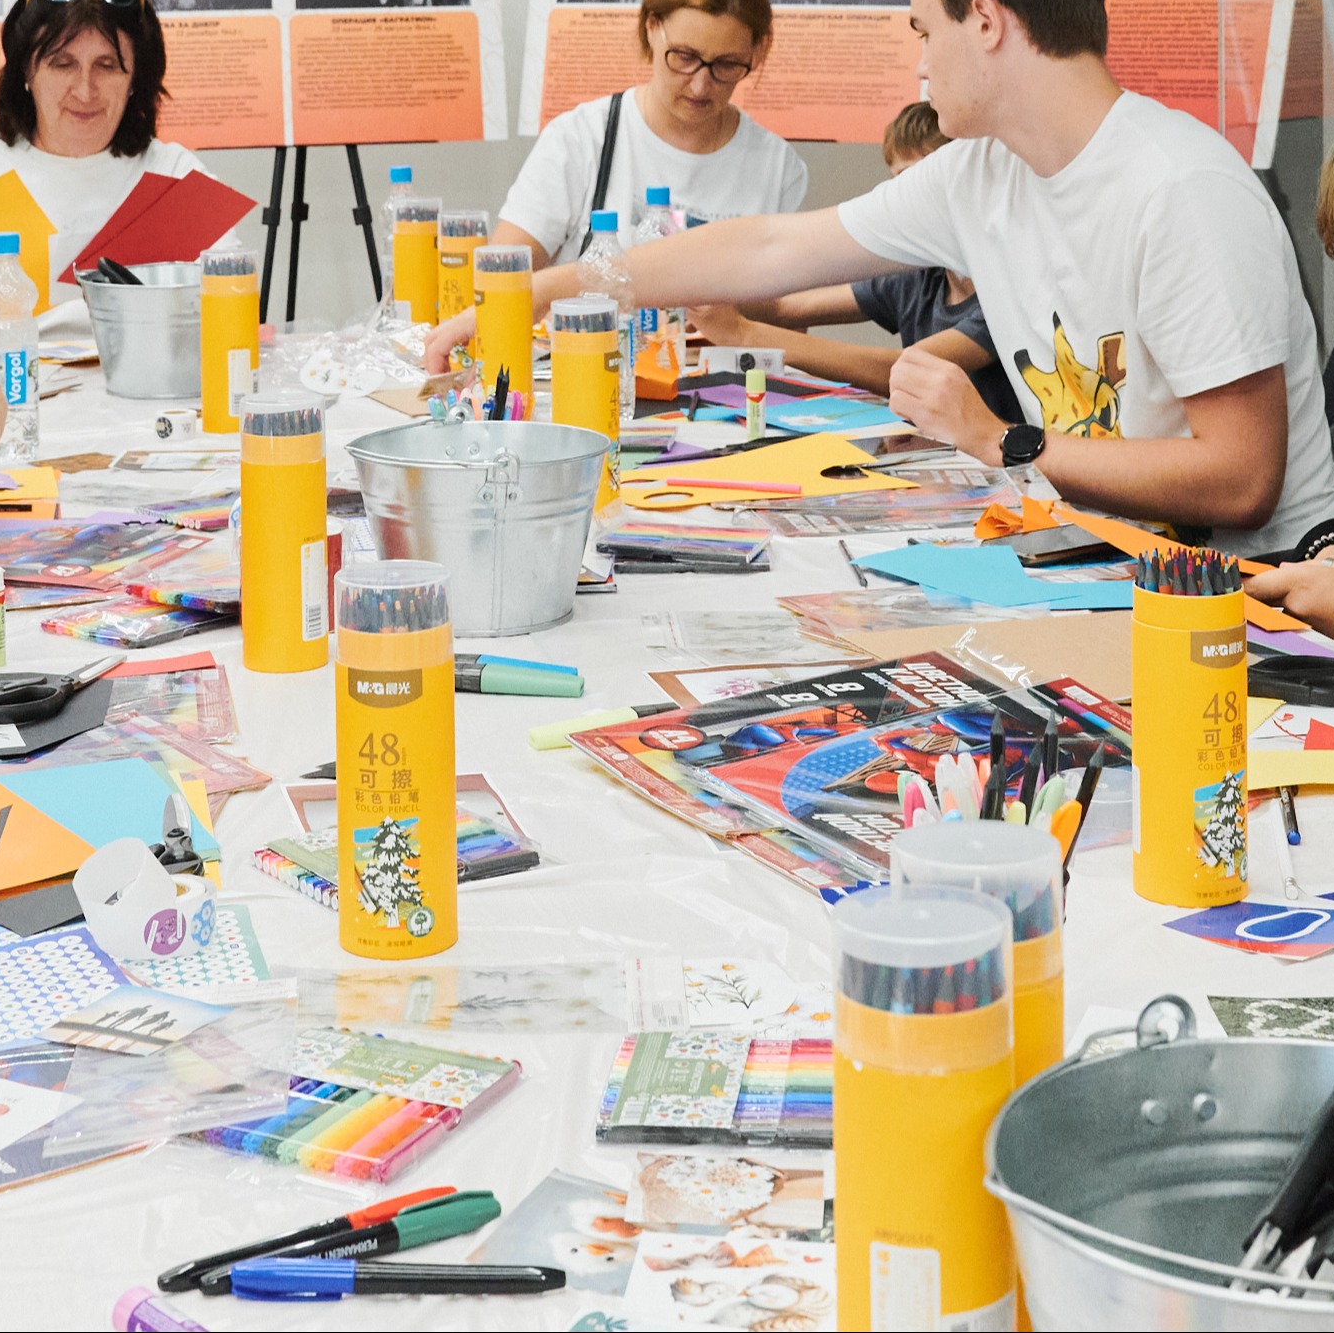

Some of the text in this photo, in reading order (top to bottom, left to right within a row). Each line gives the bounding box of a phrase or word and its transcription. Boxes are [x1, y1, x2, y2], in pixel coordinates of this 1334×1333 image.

[642, 309, 653, 330] Vor
[8, 352, 25, 404] Vorgol
[1202, 644, 1228, 658] M&G
[356, 680, 385, 695] M&G
[385, 681, 411, 695] 晨光
[826, 681, 865, 693] 8
[903, 661, 989, 703] ЦВЕТНО
[786, 692, 819, 702] 8
[1202, 690, 1238, 725] 48
[358, 731, 401, 767] 48
[1197, 762, 1227, 771] COLOR
[358, 768, 412, 790] 可擦
[355, 790, 420, 805] 彩色铅笔
[355, 803, 421, 814] COLOR PENCIL
[326, 1237, 379, 1259] PERMANENT
